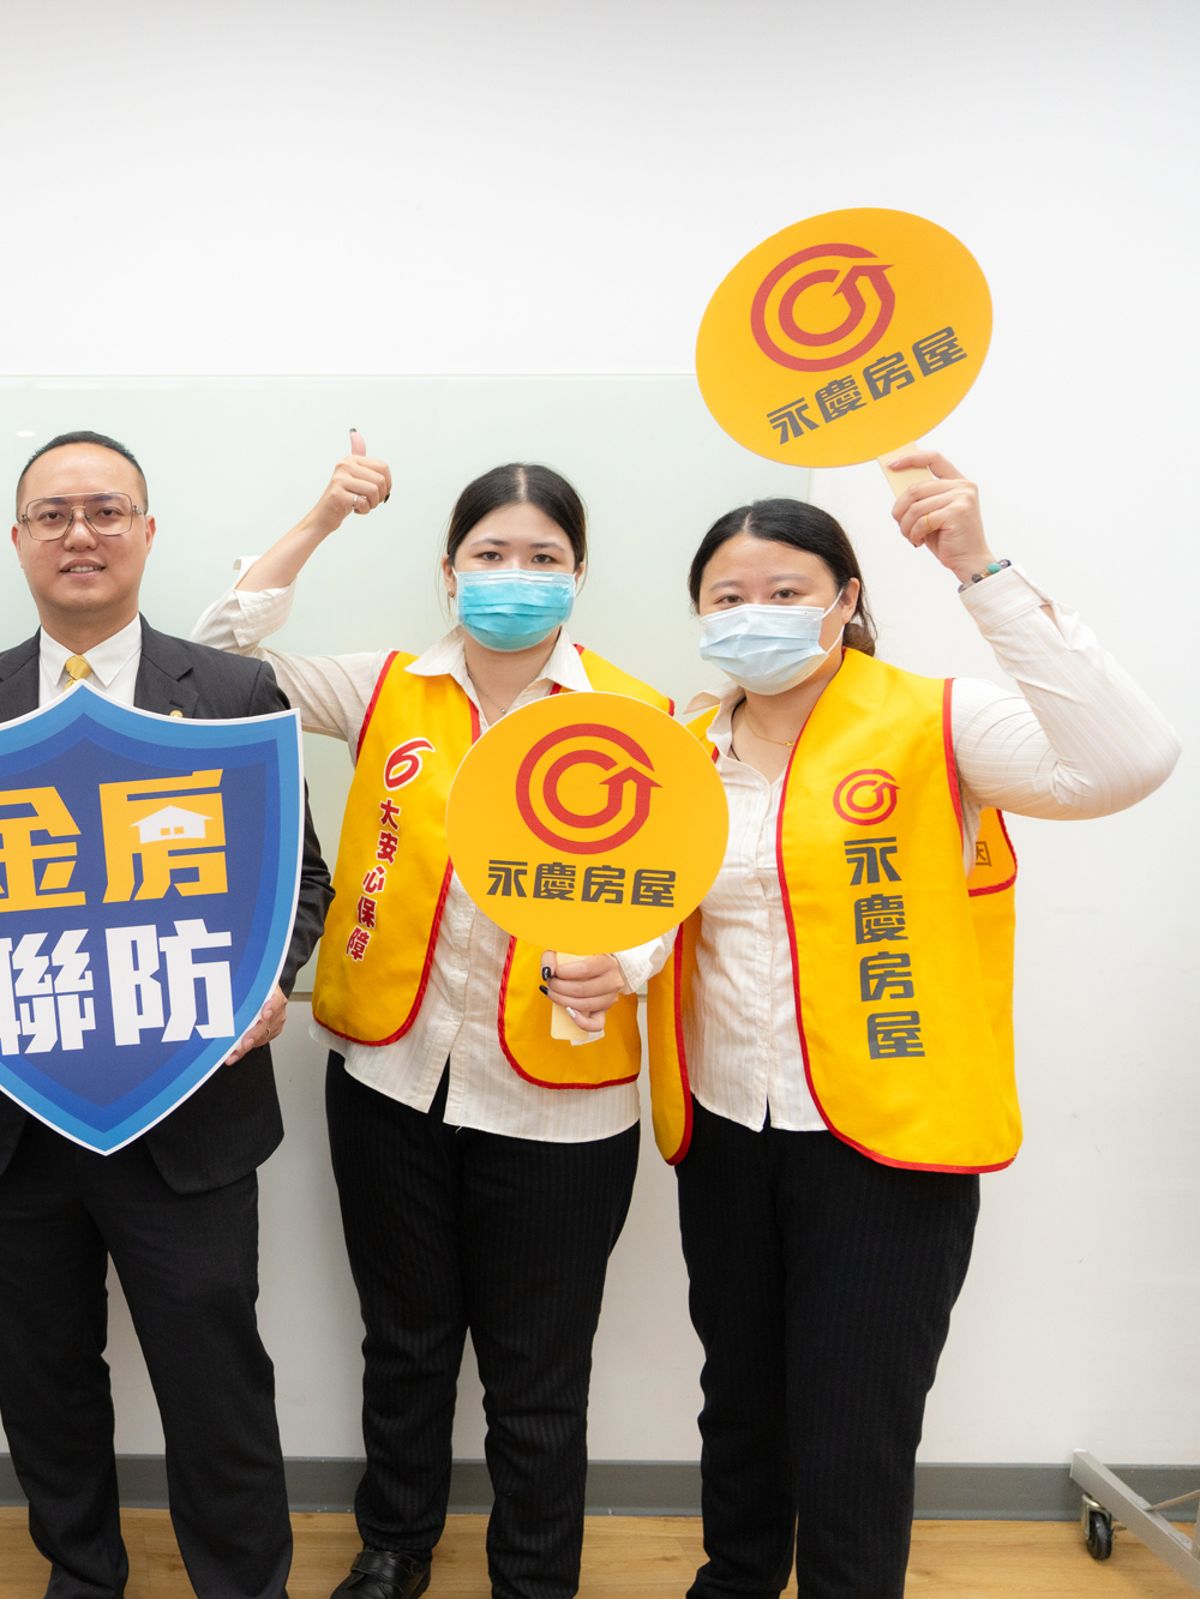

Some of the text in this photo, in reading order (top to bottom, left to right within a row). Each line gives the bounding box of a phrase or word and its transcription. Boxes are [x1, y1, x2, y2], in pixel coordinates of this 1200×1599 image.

[766, 326, 968, 445] 永慶房屋
[486, 859, 677, 908] 永慶房屋
[844, 836, 926, 1060] 永慶房屋
